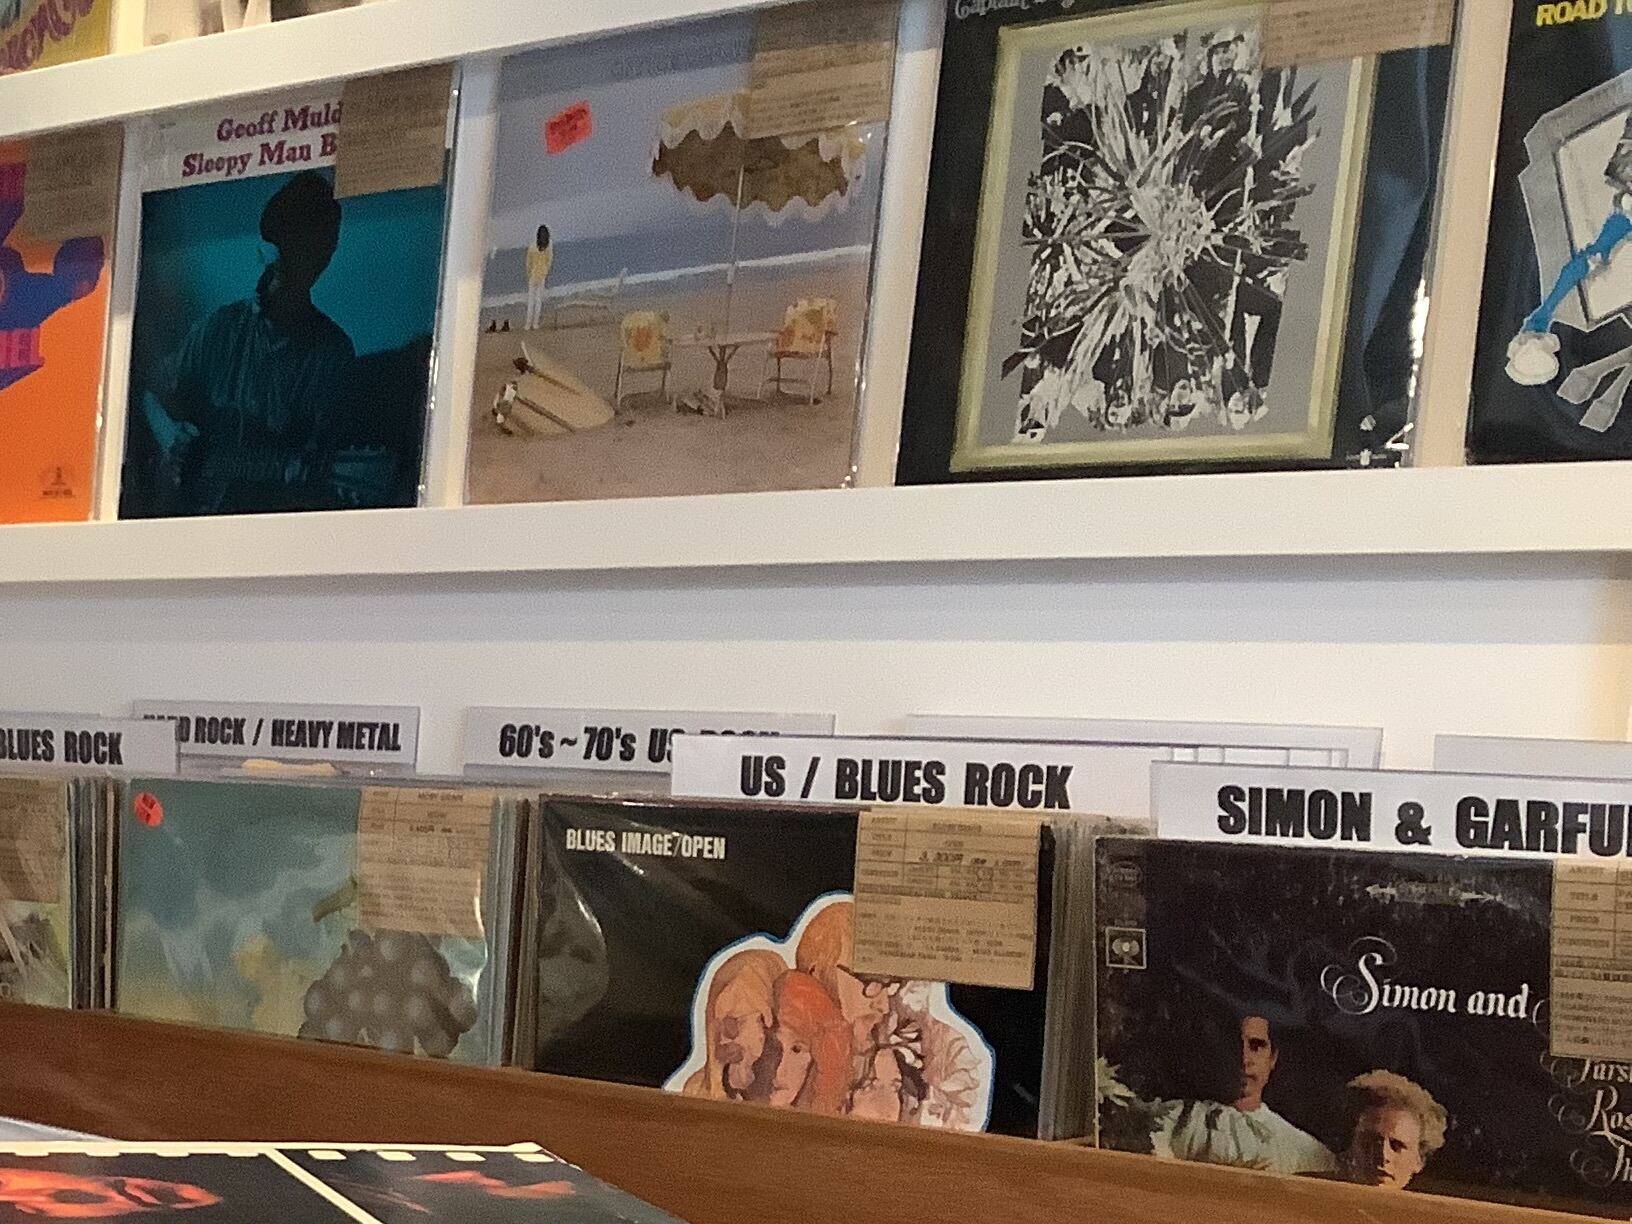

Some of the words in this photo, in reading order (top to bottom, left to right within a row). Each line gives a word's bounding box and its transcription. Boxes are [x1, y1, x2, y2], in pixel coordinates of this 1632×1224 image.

[1536, 0, 1608, 27] ROAD
[217, 109, 278, 142] Geoff
[182, 150, 252, 178] Sleepy
[259, 139, 312, 167] Man
[64, 731, 124, 766] ROCK
[194, 715, 246, 746] ROCK
[271, 719, 335, 749] HEAVY
[336, 721, 402, 751] METAL
[740, 755, 787, 798] US
[834, 758, 947, 805] BLUES
[963, 762, 1075, 810] ROCK
[1217, 785, 1373, 843] SIMON
[1394, 801, 1433, 846] &
[1455, 796, 1632, 858] GARFU
[566, 828, 617, 852] BLUES
[1321, 936, 1456, 1016] Simon
[1467, 983, 1529, 1020] and
